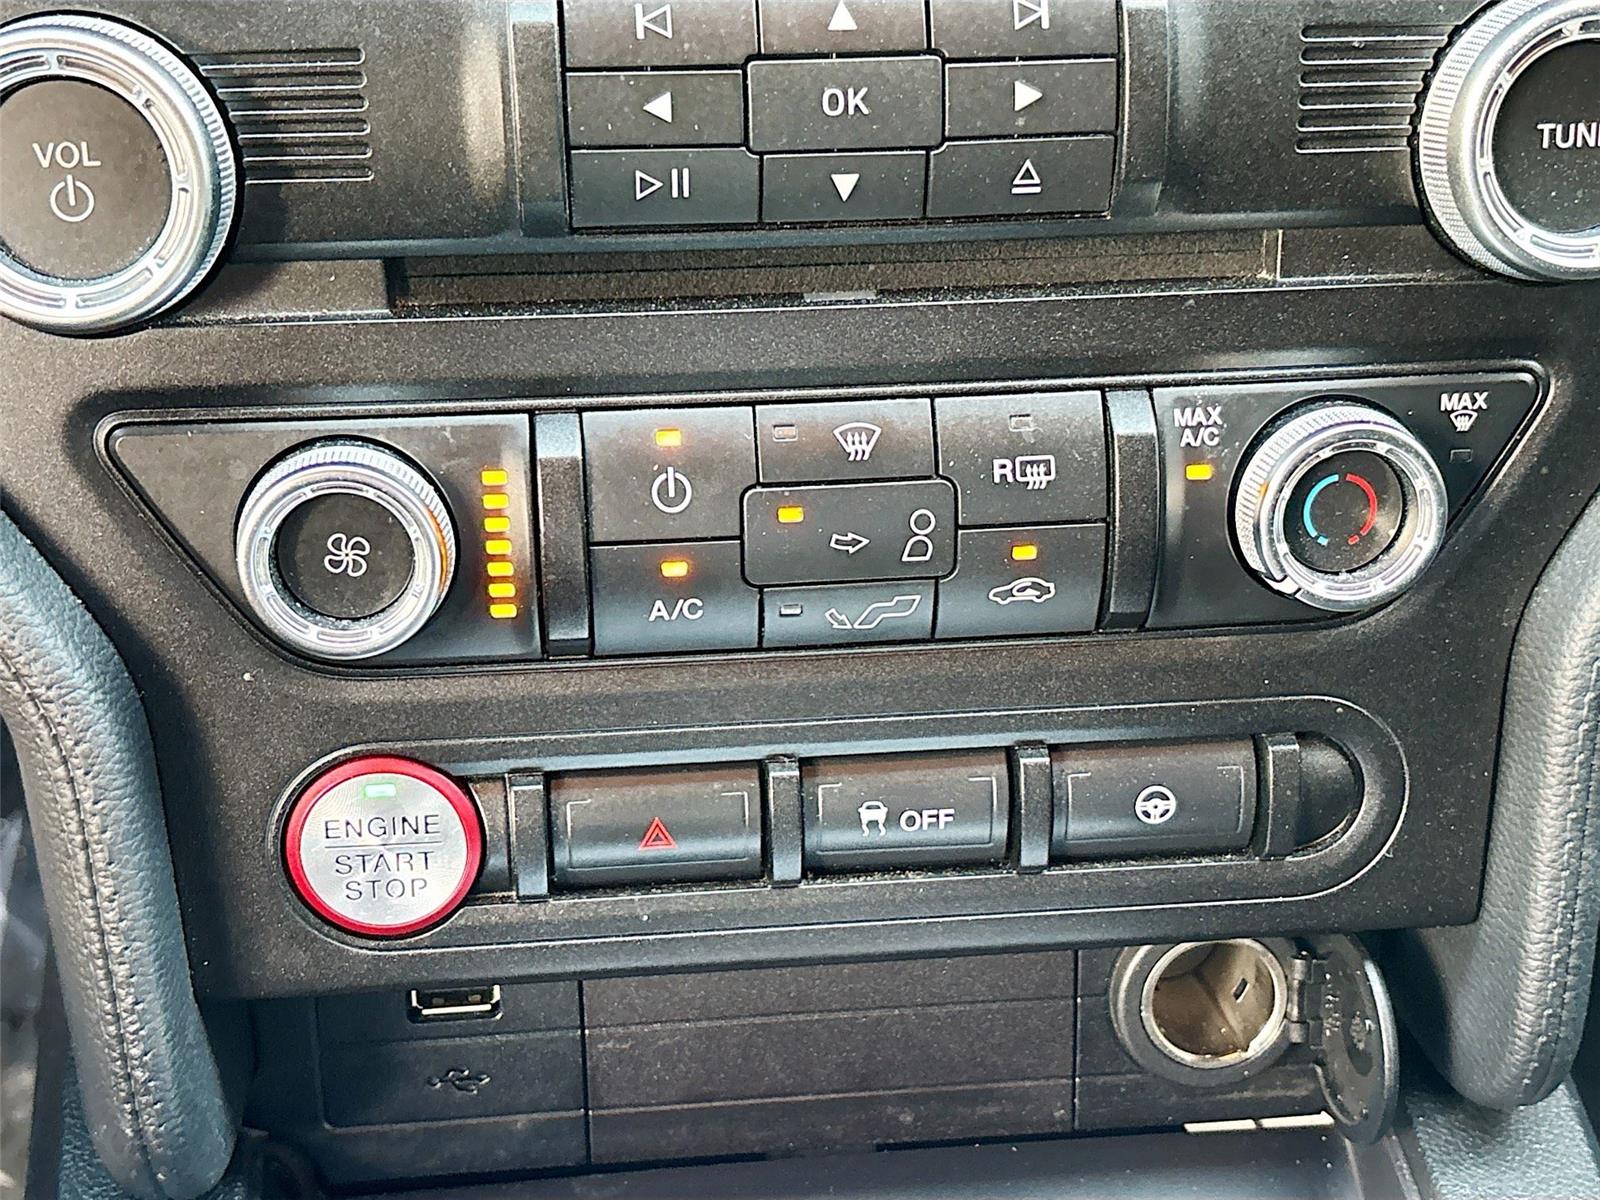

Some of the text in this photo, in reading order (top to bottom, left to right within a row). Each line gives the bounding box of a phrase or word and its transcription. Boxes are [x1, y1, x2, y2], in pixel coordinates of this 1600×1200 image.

[821, 86, 869, 118] OK
[1536, 121, 1600, 149] TUN
[32, 141, 102, 169] VOL
[1440, 391, 1489, 411] MAX
[1173, 406, 1222, 427] MAX
[1180, 427, 1220, 447] A/C
[993, 458, 1013, 484] R
[648, 599, 704, 623] A/C
[324, 814, 441, 839] ENGINE
[898, 807, 955, 832] OFF
[335, 851, 434, 875] START
[345, 878, 428, 901] STOP
